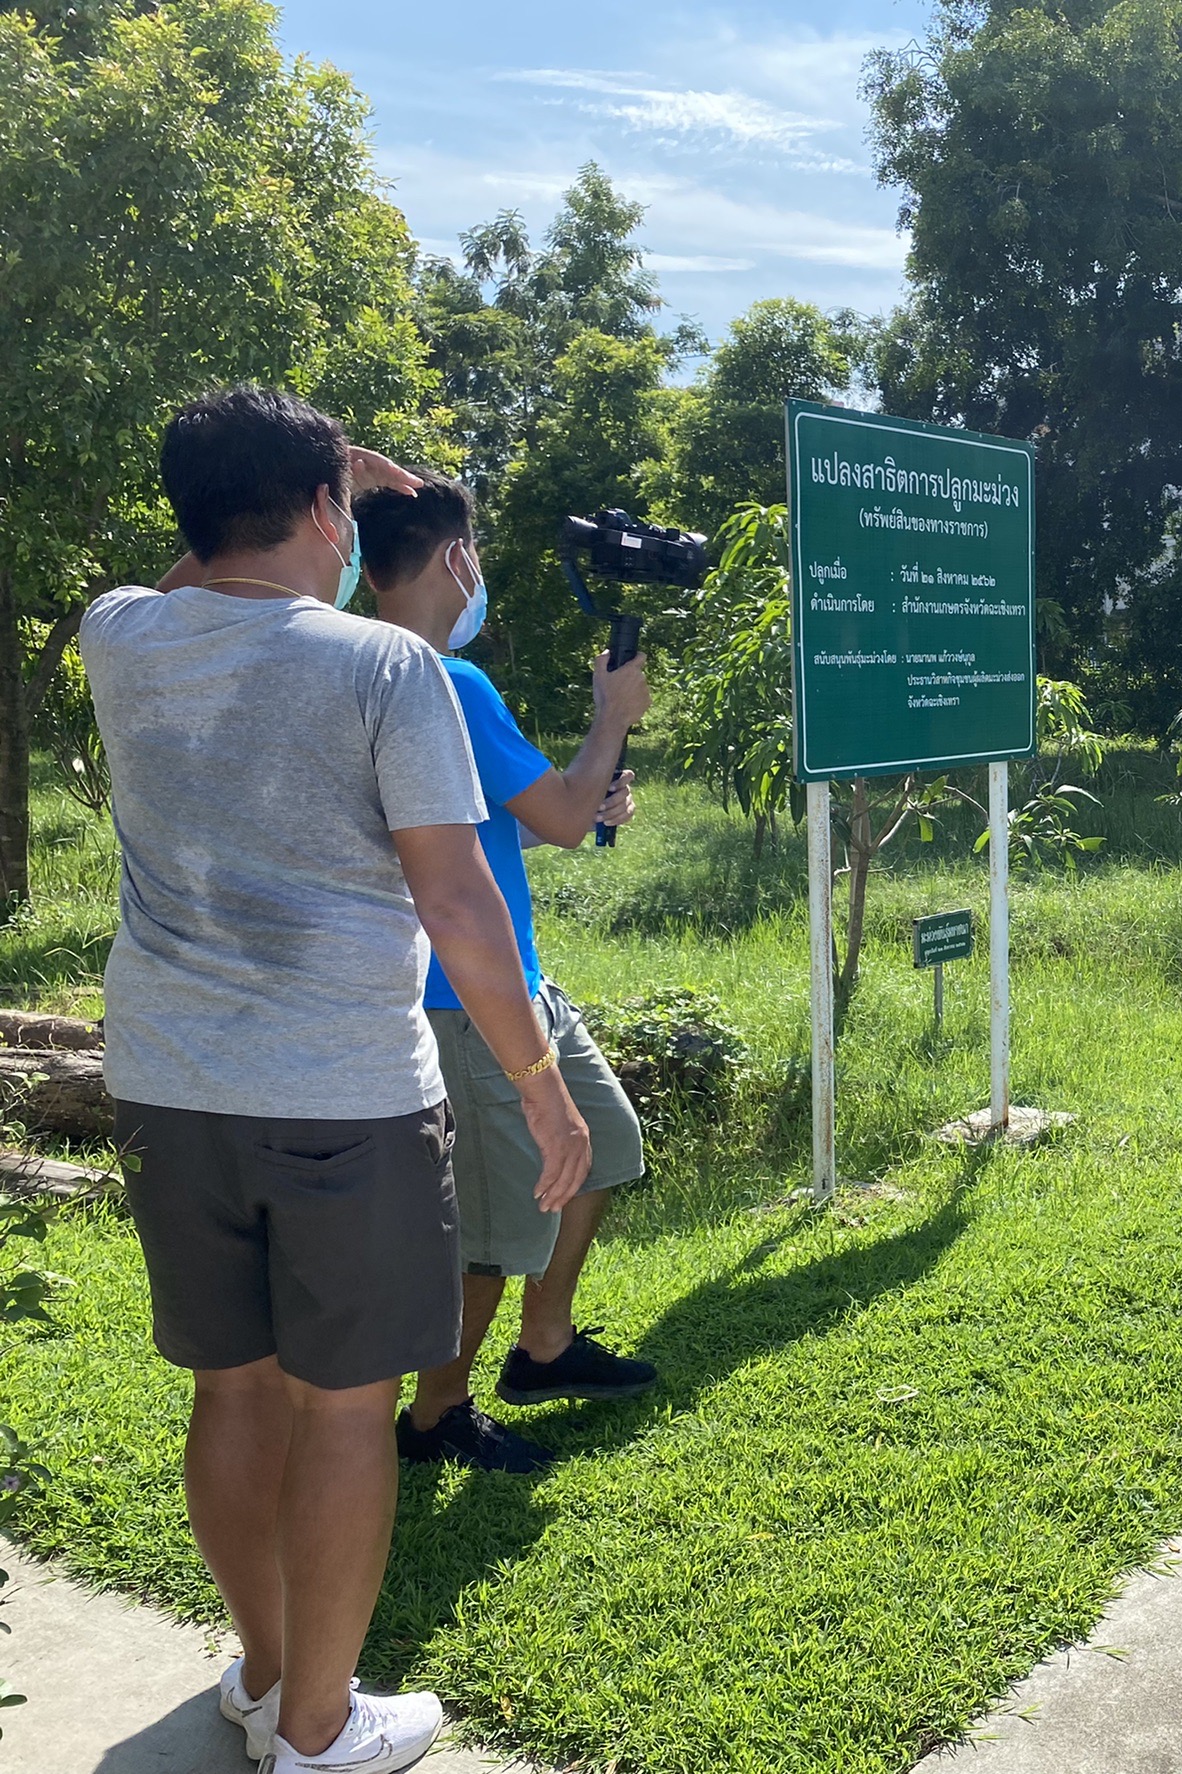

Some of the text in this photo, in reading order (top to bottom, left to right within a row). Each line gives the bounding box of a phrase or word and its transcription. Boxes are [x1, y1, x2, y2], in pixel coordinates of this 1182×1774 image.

[811, 452, 1019, 512] แปลงสาธิตการปลูกมะม่วง
[859, 506, 988, 539] (ทรัพย์สินของทางราชการ)
[809, 557, 847, 585] ปลูกเมื่อ
[900, 562, 918, 583] วันที่
[937, 567, 969, 586] สิงหาคม
[810, 592, 875, 614] ดำเนินการโดย
